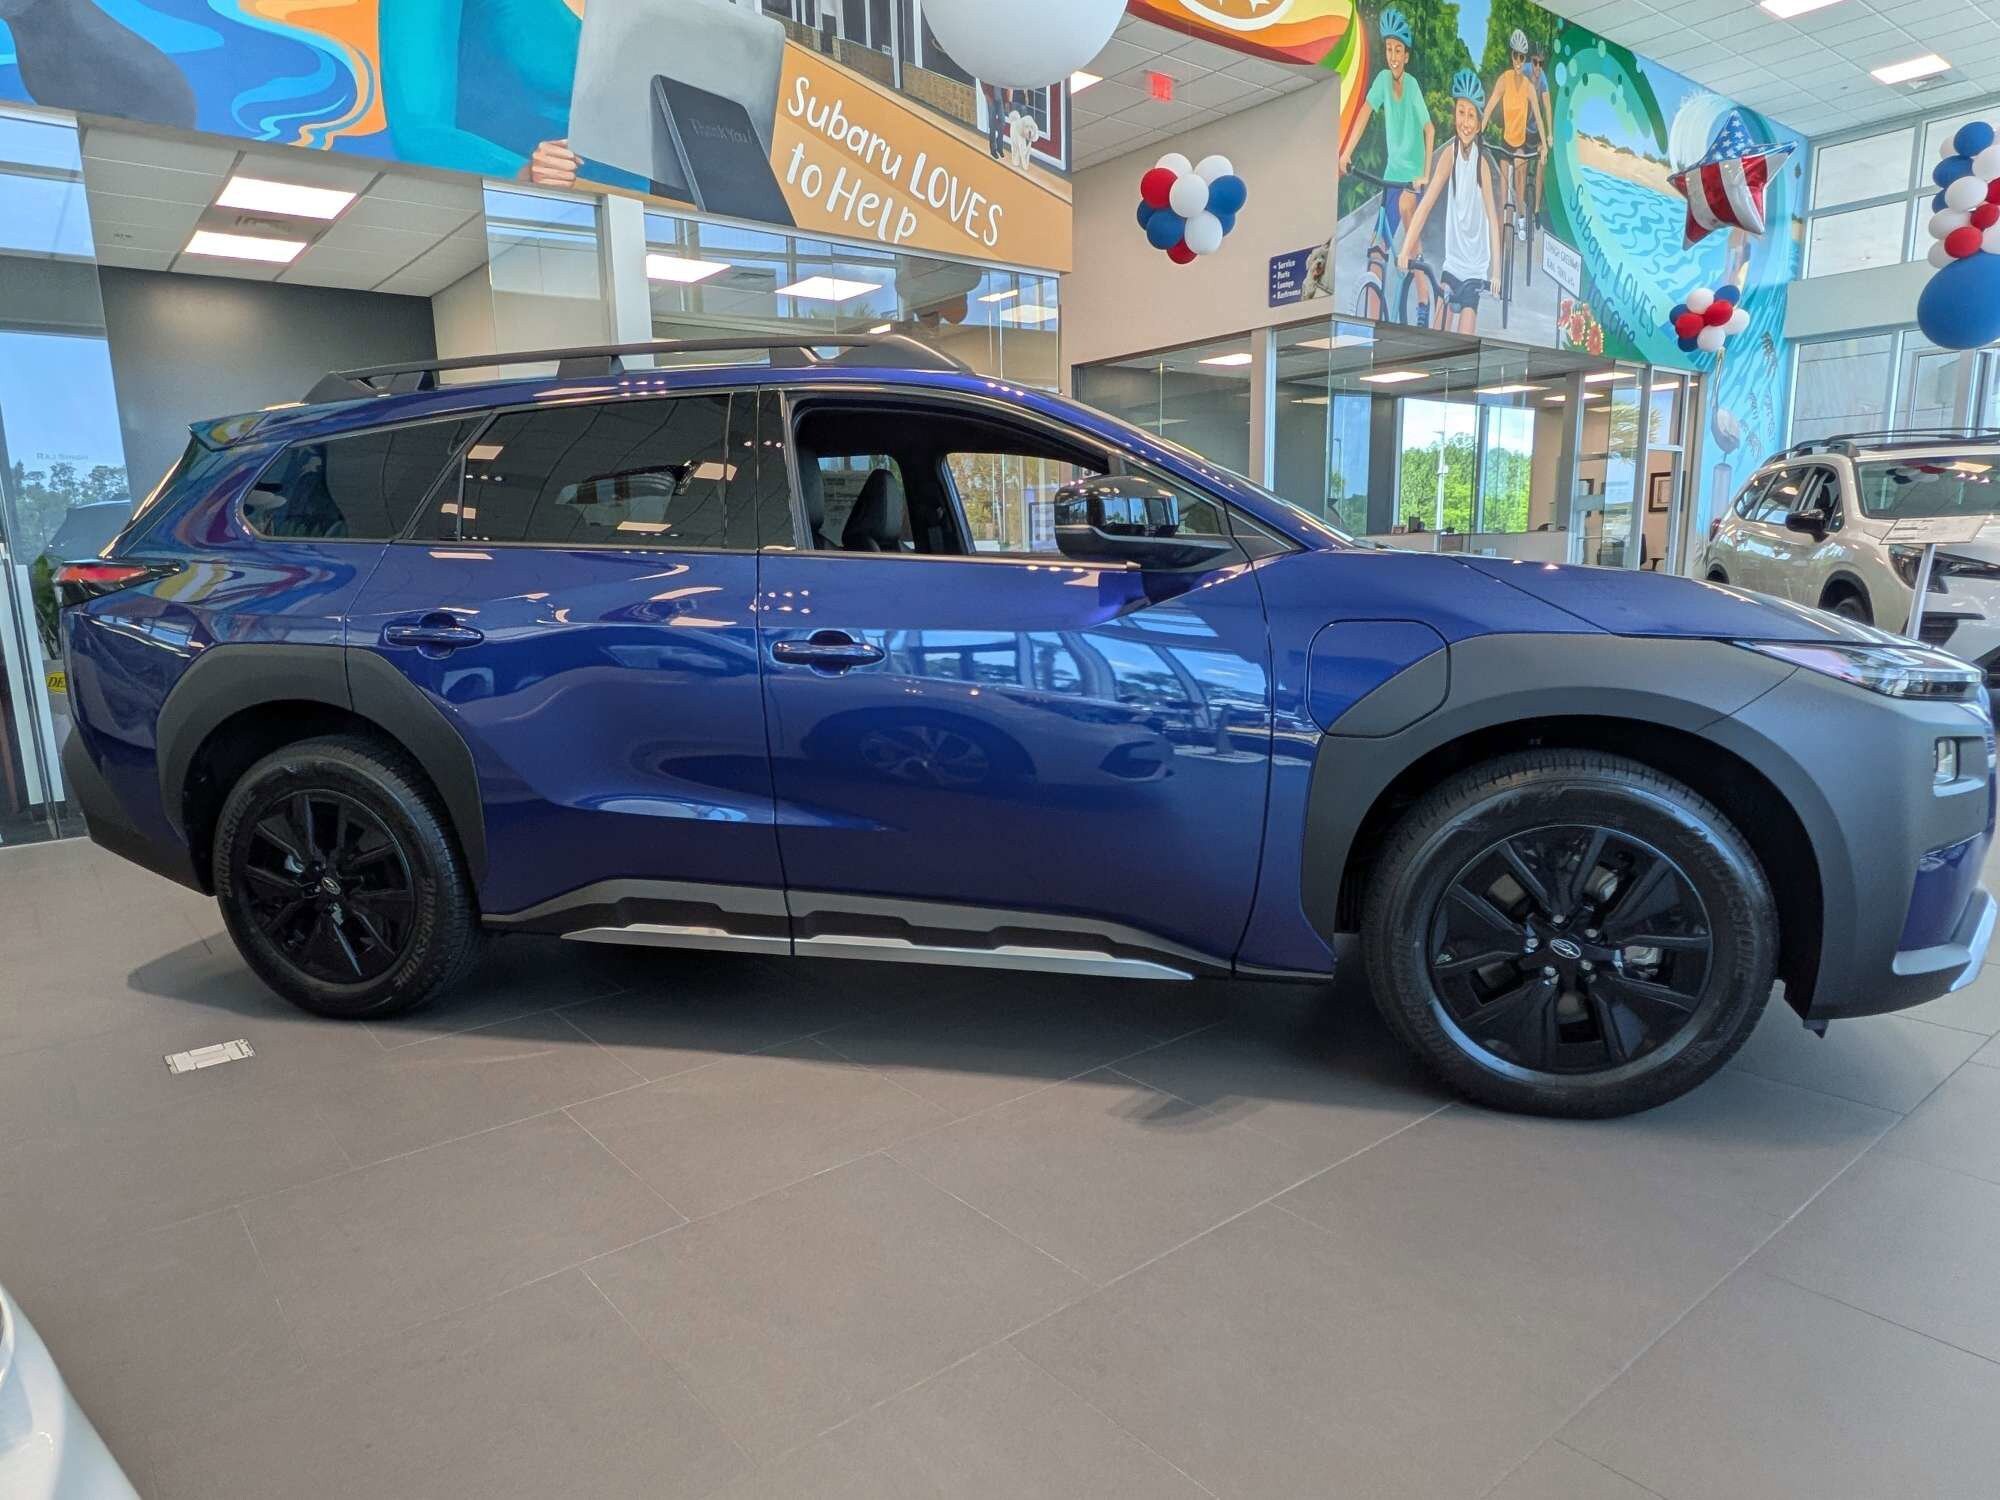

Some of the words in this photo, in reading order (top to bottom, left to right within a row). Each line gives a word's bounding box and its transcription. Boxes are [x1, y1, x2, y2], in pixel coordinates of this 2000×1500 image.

[785, 142, 823, 198] to
[825, 166, 917, 244] Help
[787, 76, 902, 181] Subaru
[909, 152, 1003, 247] LOVES
[1569, 184, 1611, 279] Subaru
[1613, 262, 1657, 337] LOVES
[1587, 273, 1601, 310] to
[1600, 297, 1636, 343] Care
